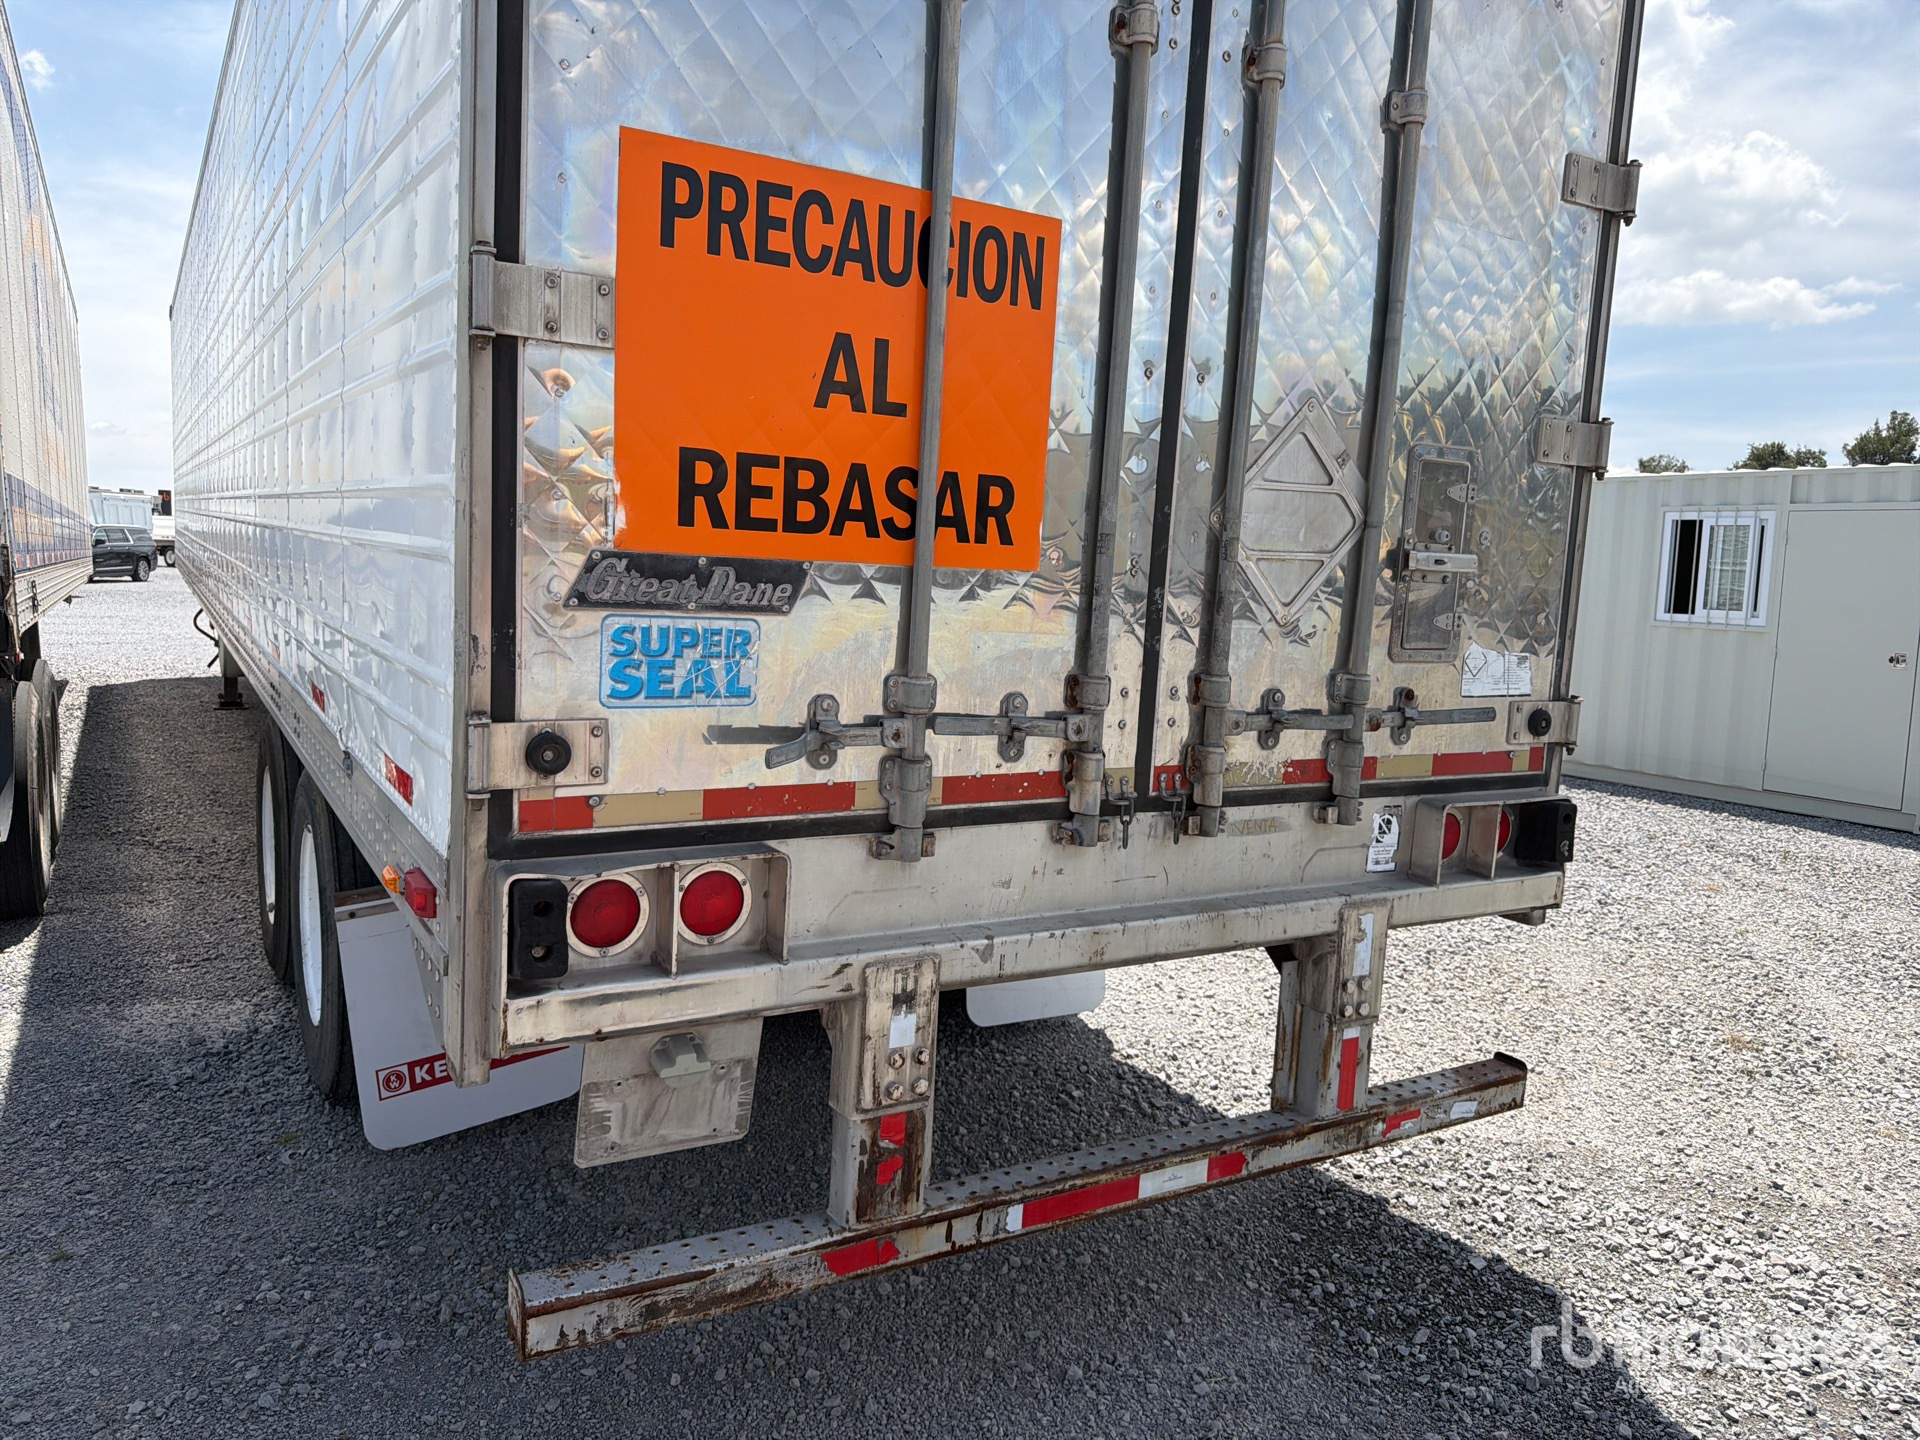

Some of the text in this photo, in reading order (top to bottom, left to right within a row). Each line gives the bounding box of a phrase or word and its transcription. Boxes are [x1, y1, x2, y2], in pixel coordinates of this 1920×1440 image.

[660, 161, 1045, 310] PRECAUCION
[813, 332, 907, 418] AL
[678, 446, 1015, 546] REBASAR
[585, 557, 793, 607] Great Dane
[608, 624, 753, 659] SUPER
[606, 659, 751, 700] SEAL
